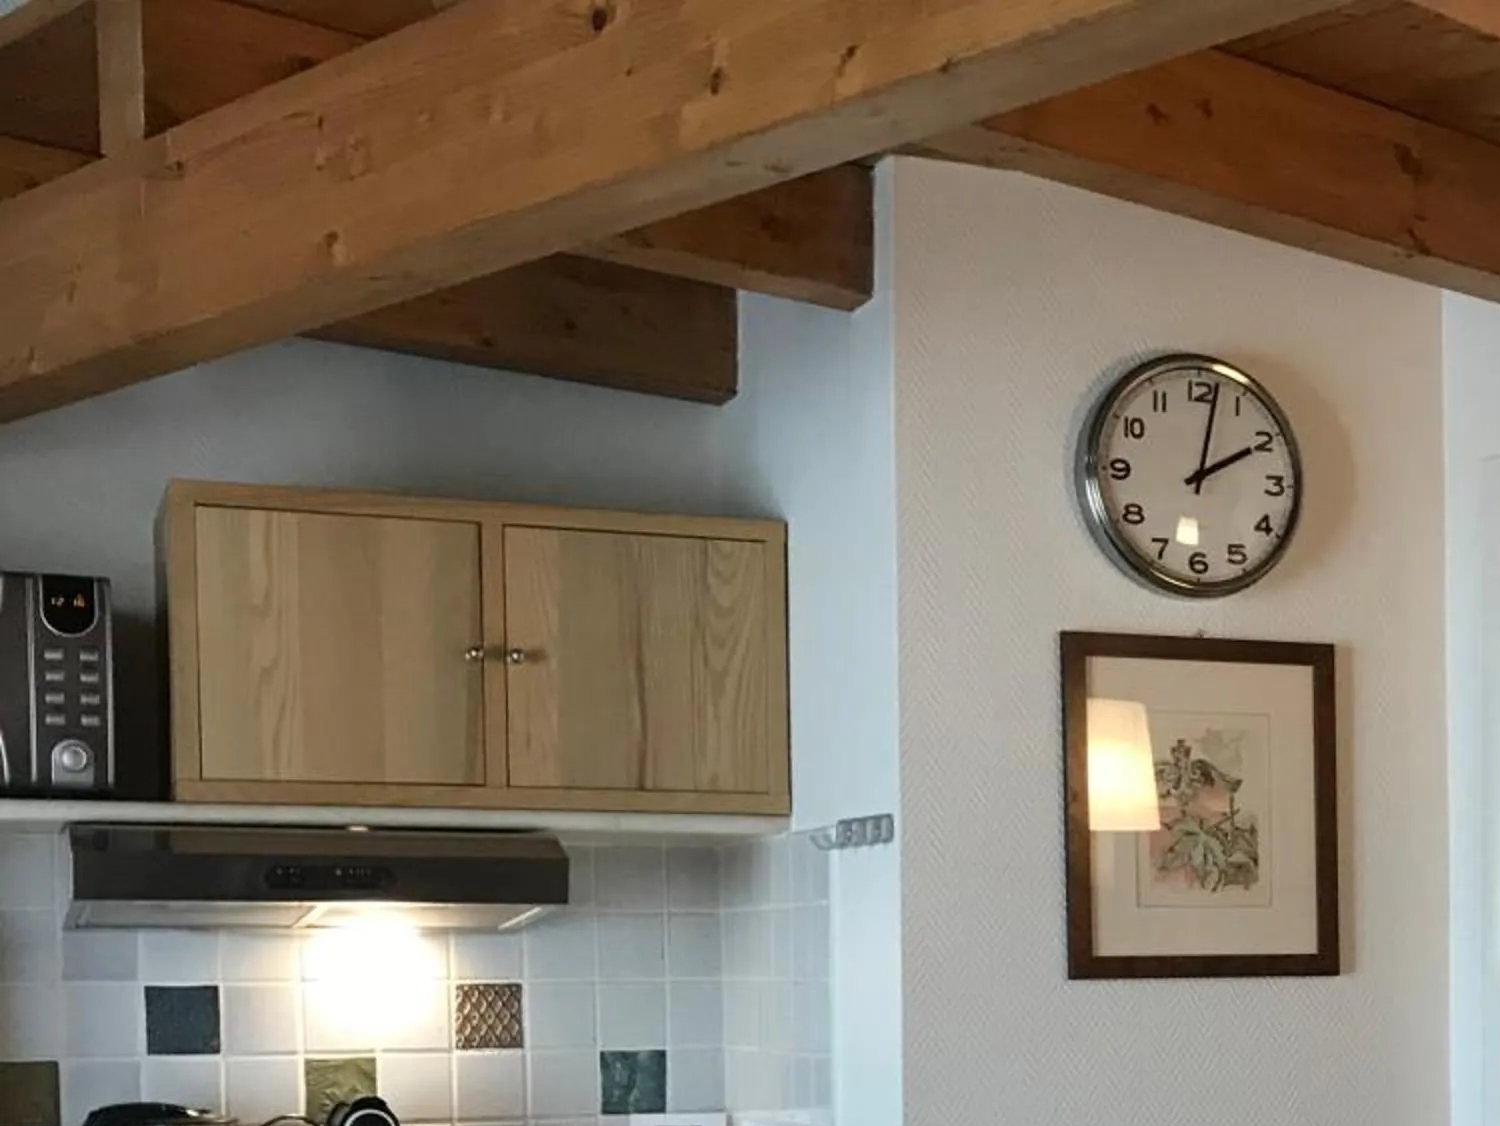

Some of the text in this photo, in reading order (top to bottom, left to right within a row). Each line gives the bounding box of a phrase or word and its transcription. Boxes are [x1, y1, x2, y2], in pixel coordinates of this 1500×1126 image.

[1152, 391, 1167, 413] 11
[1187, 379, 1213, 404] 12
[1234, 396, 1240, 416] 1
[1123, 417, 1145, 439] 10
[1254, 431, 1274, 452] 2
[1109, 458, 1131, 480] 9
[1264, 475, 1285, 497] 3
[1122, 503, 1145, 525] 8
[1254, 514, 1274, 537] 4
[1151, 537, 1169, 560] 7
[1227, 543, 1249, 565] 5
[1188, 552, 1209, 574] 6
